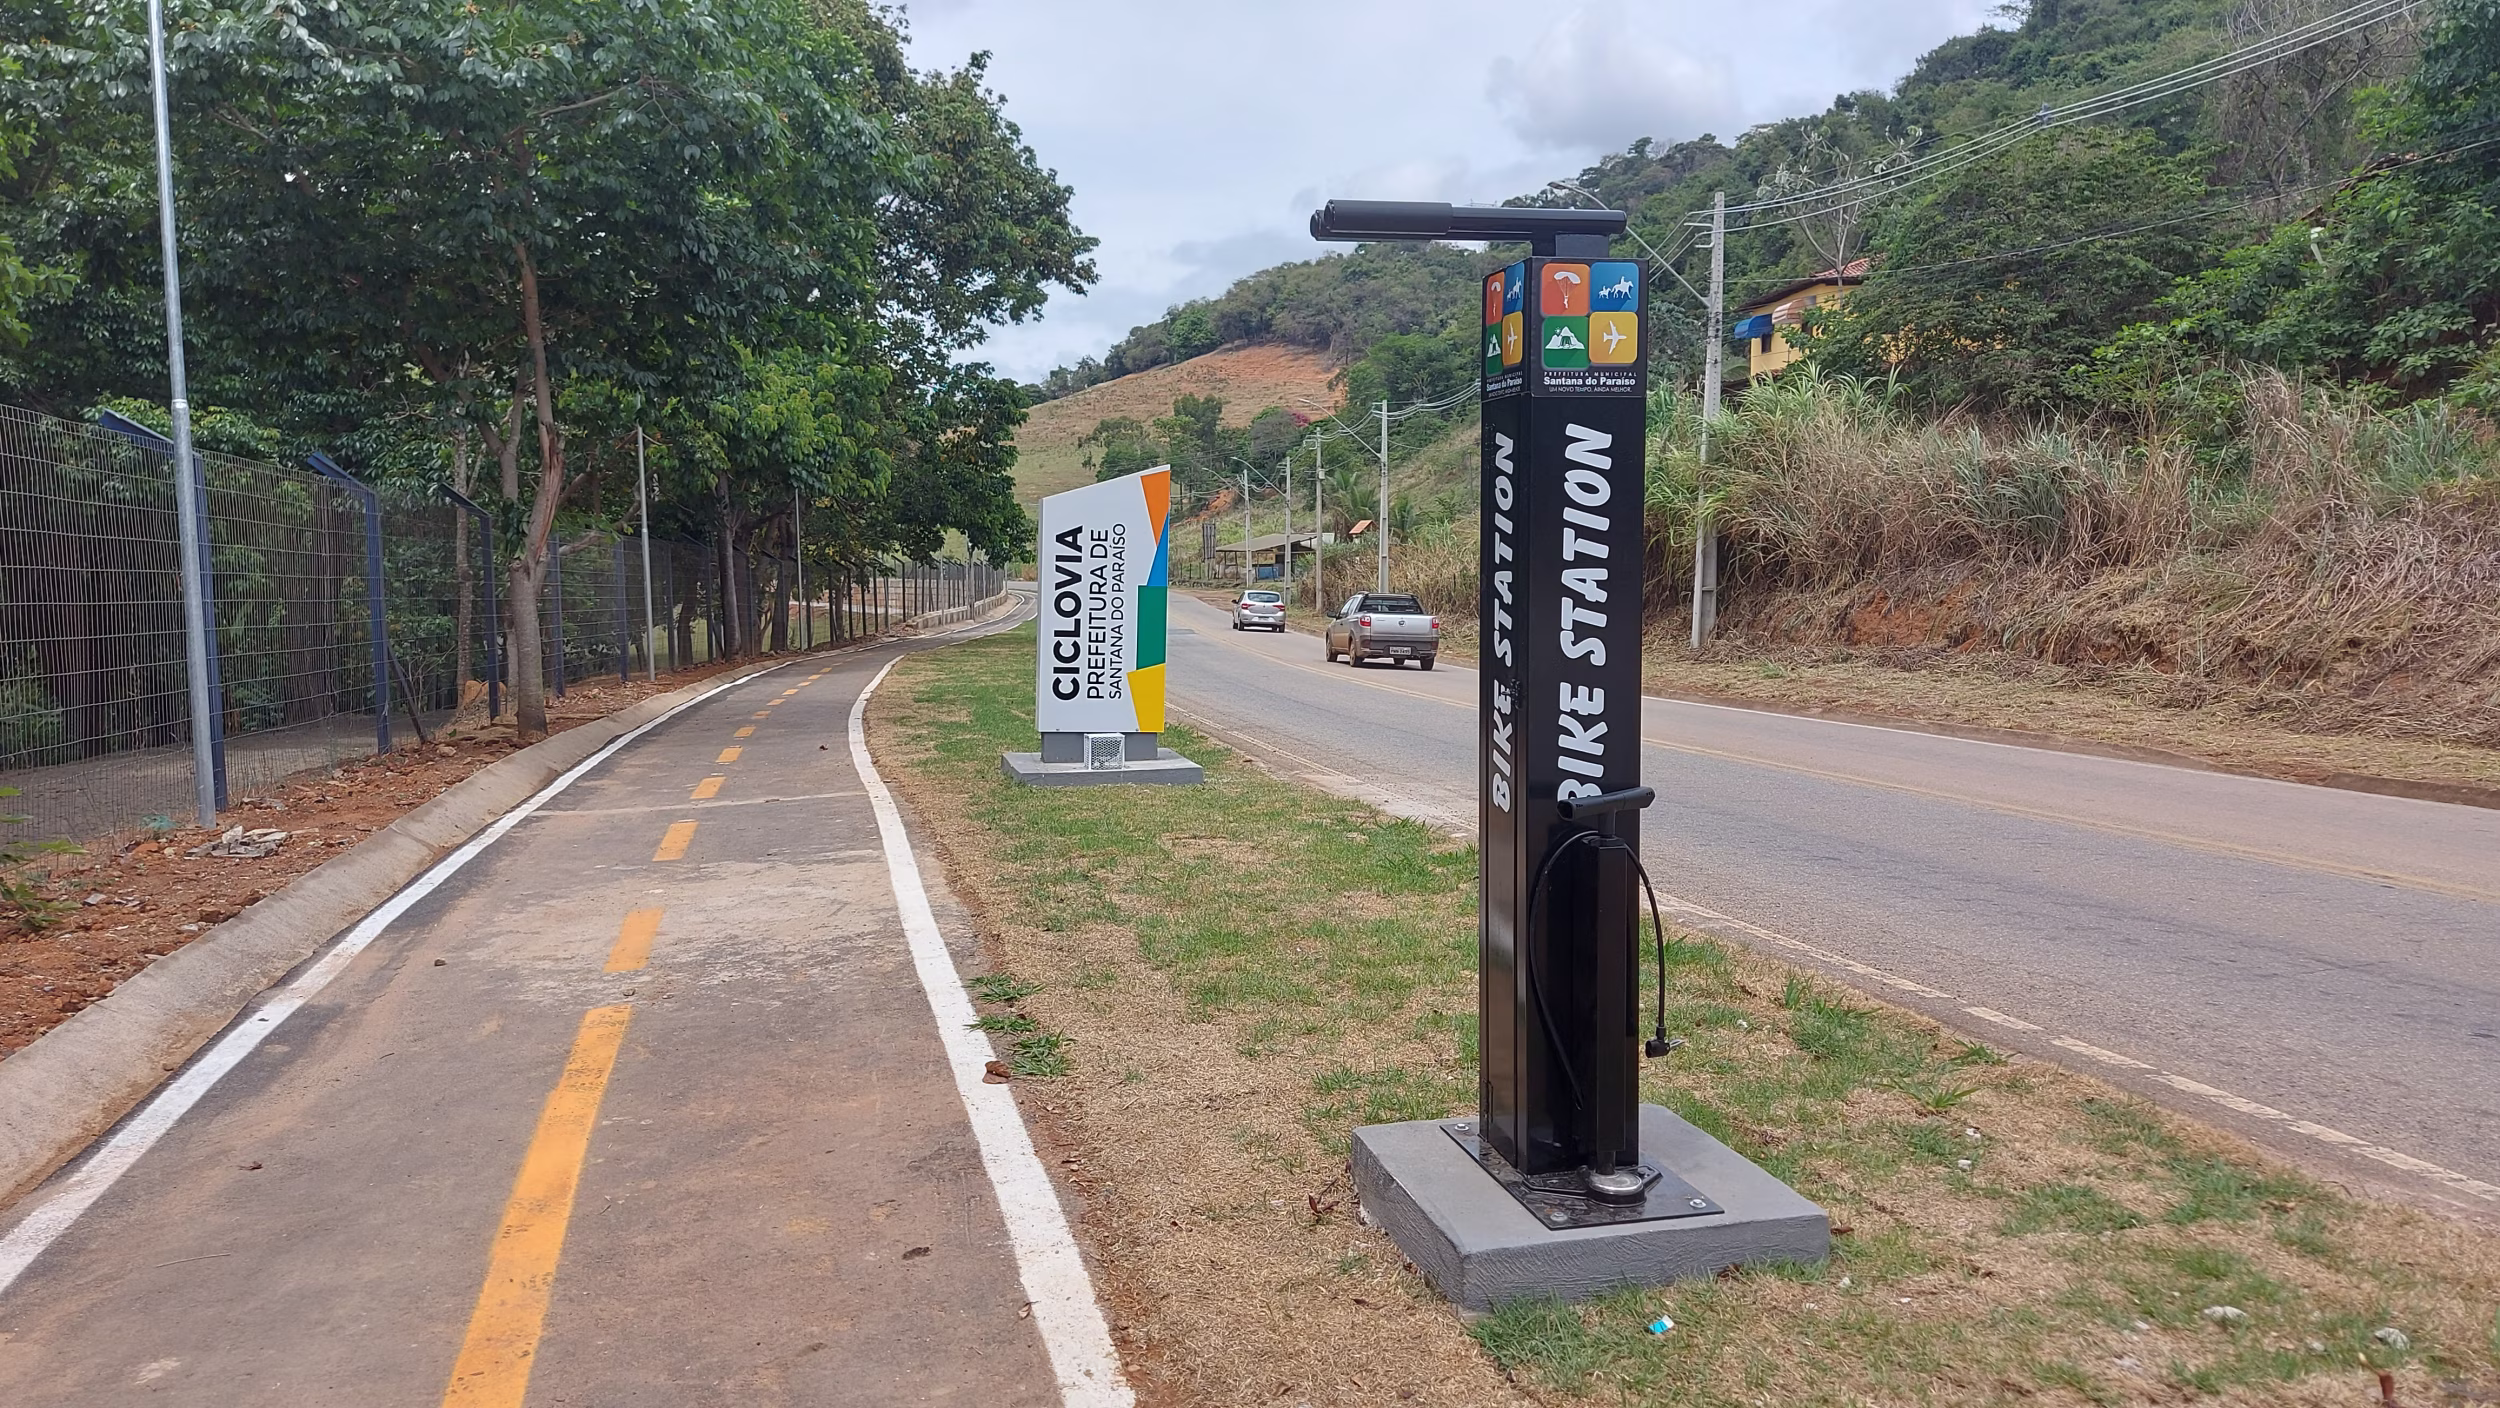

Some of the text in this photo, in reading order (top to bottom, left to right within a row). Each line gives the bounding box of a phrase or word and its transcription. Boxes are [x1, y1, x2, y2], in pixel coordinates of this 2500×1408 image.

[1543, 376, 1636, 385] Santana do Paraíso
[1052, 525, 1084, 701] CICLOVIA
[1087, 530, 1109, 700] PREFEITURA DE
[1109, 523, 1126, 700] SANTANA DO PARAÍSO
[1492, 432, 1514, 813] BIKE STATION
[1559, 423, 1613, 667] STATION
